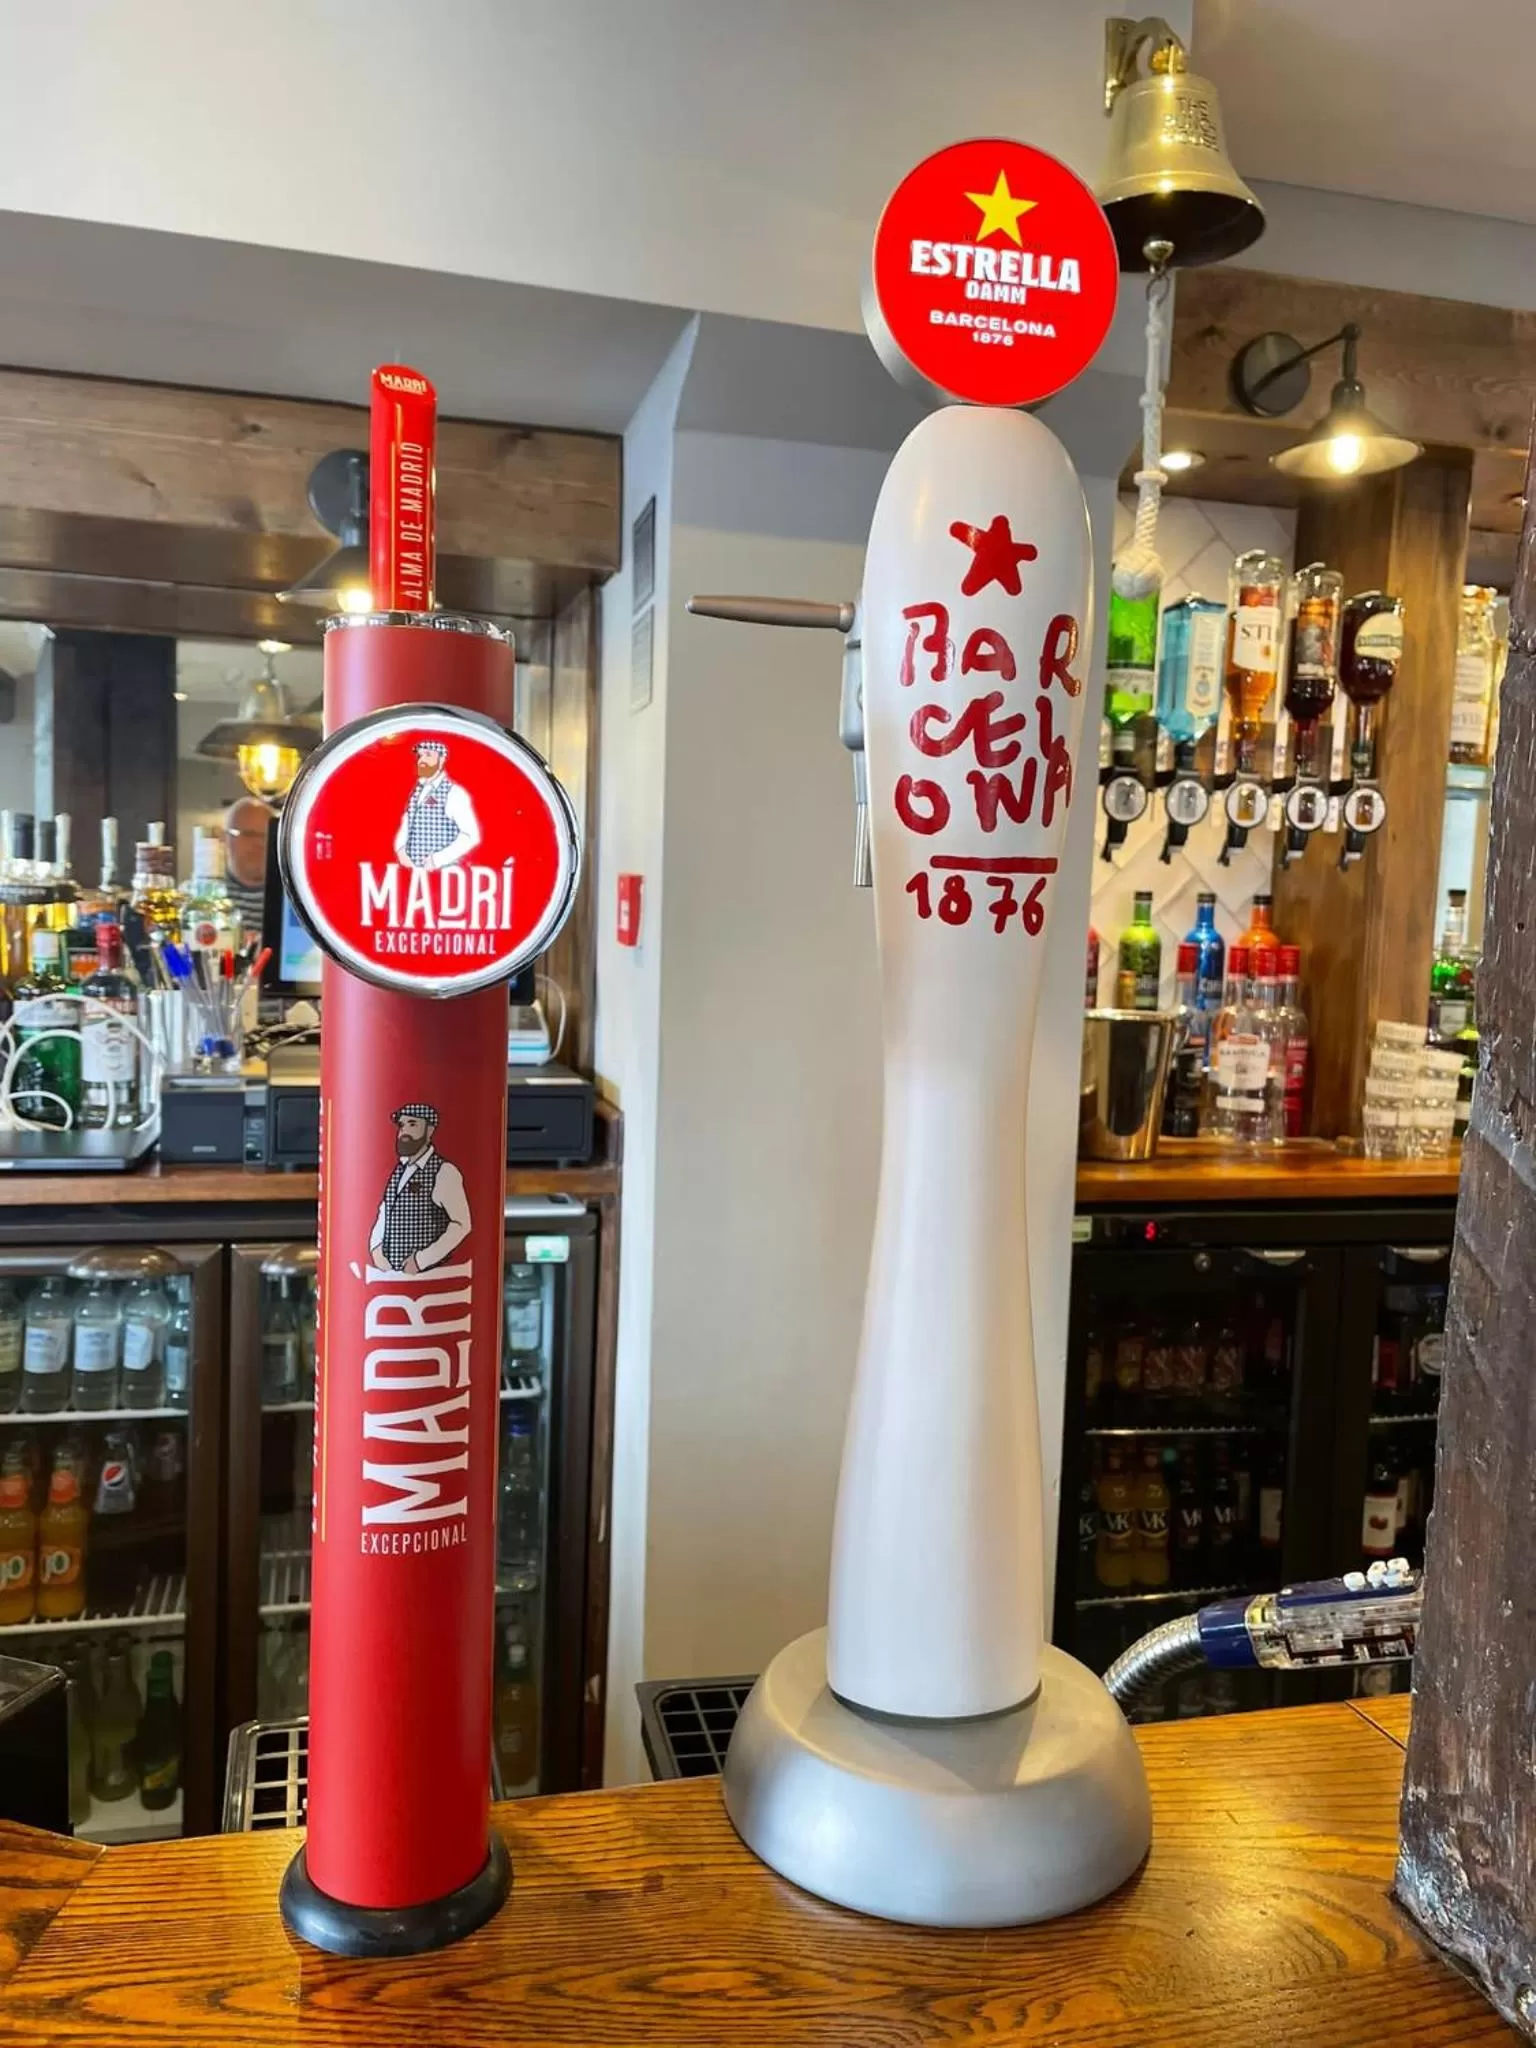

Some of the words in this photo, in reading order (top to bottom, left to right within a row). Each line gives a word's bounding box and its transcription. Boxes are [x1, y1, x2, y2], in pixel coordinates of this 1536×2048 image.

[910, 239, 1081, 294] ESTRELLA
[965, 279, 1027, 305] DAMM
[929, 309, 1057, 338] BARCELONA
[972, 331, 1014, 346] 1876
[400, 442, 423, 513] MADRID
[401, 520, 423, 543] DE
[401, 551, 423, 600] ALMA
[899, 601, 1081, 697] BAR
[909, 691, 1059, 769] CEL
[894, 735, 1073, 835] ONA
[359, 855, 515, 930] MADRÍ
[905, 872, 1048, 936] 1876
[374, 930, 497, 956] EXCEPCIONAL
[349, 1258, 473, 1526] MADRÍ
[361, 1522, 468, 1555] EXCEPCIONAL
[1142, 1511, 1166, 1530] VK
